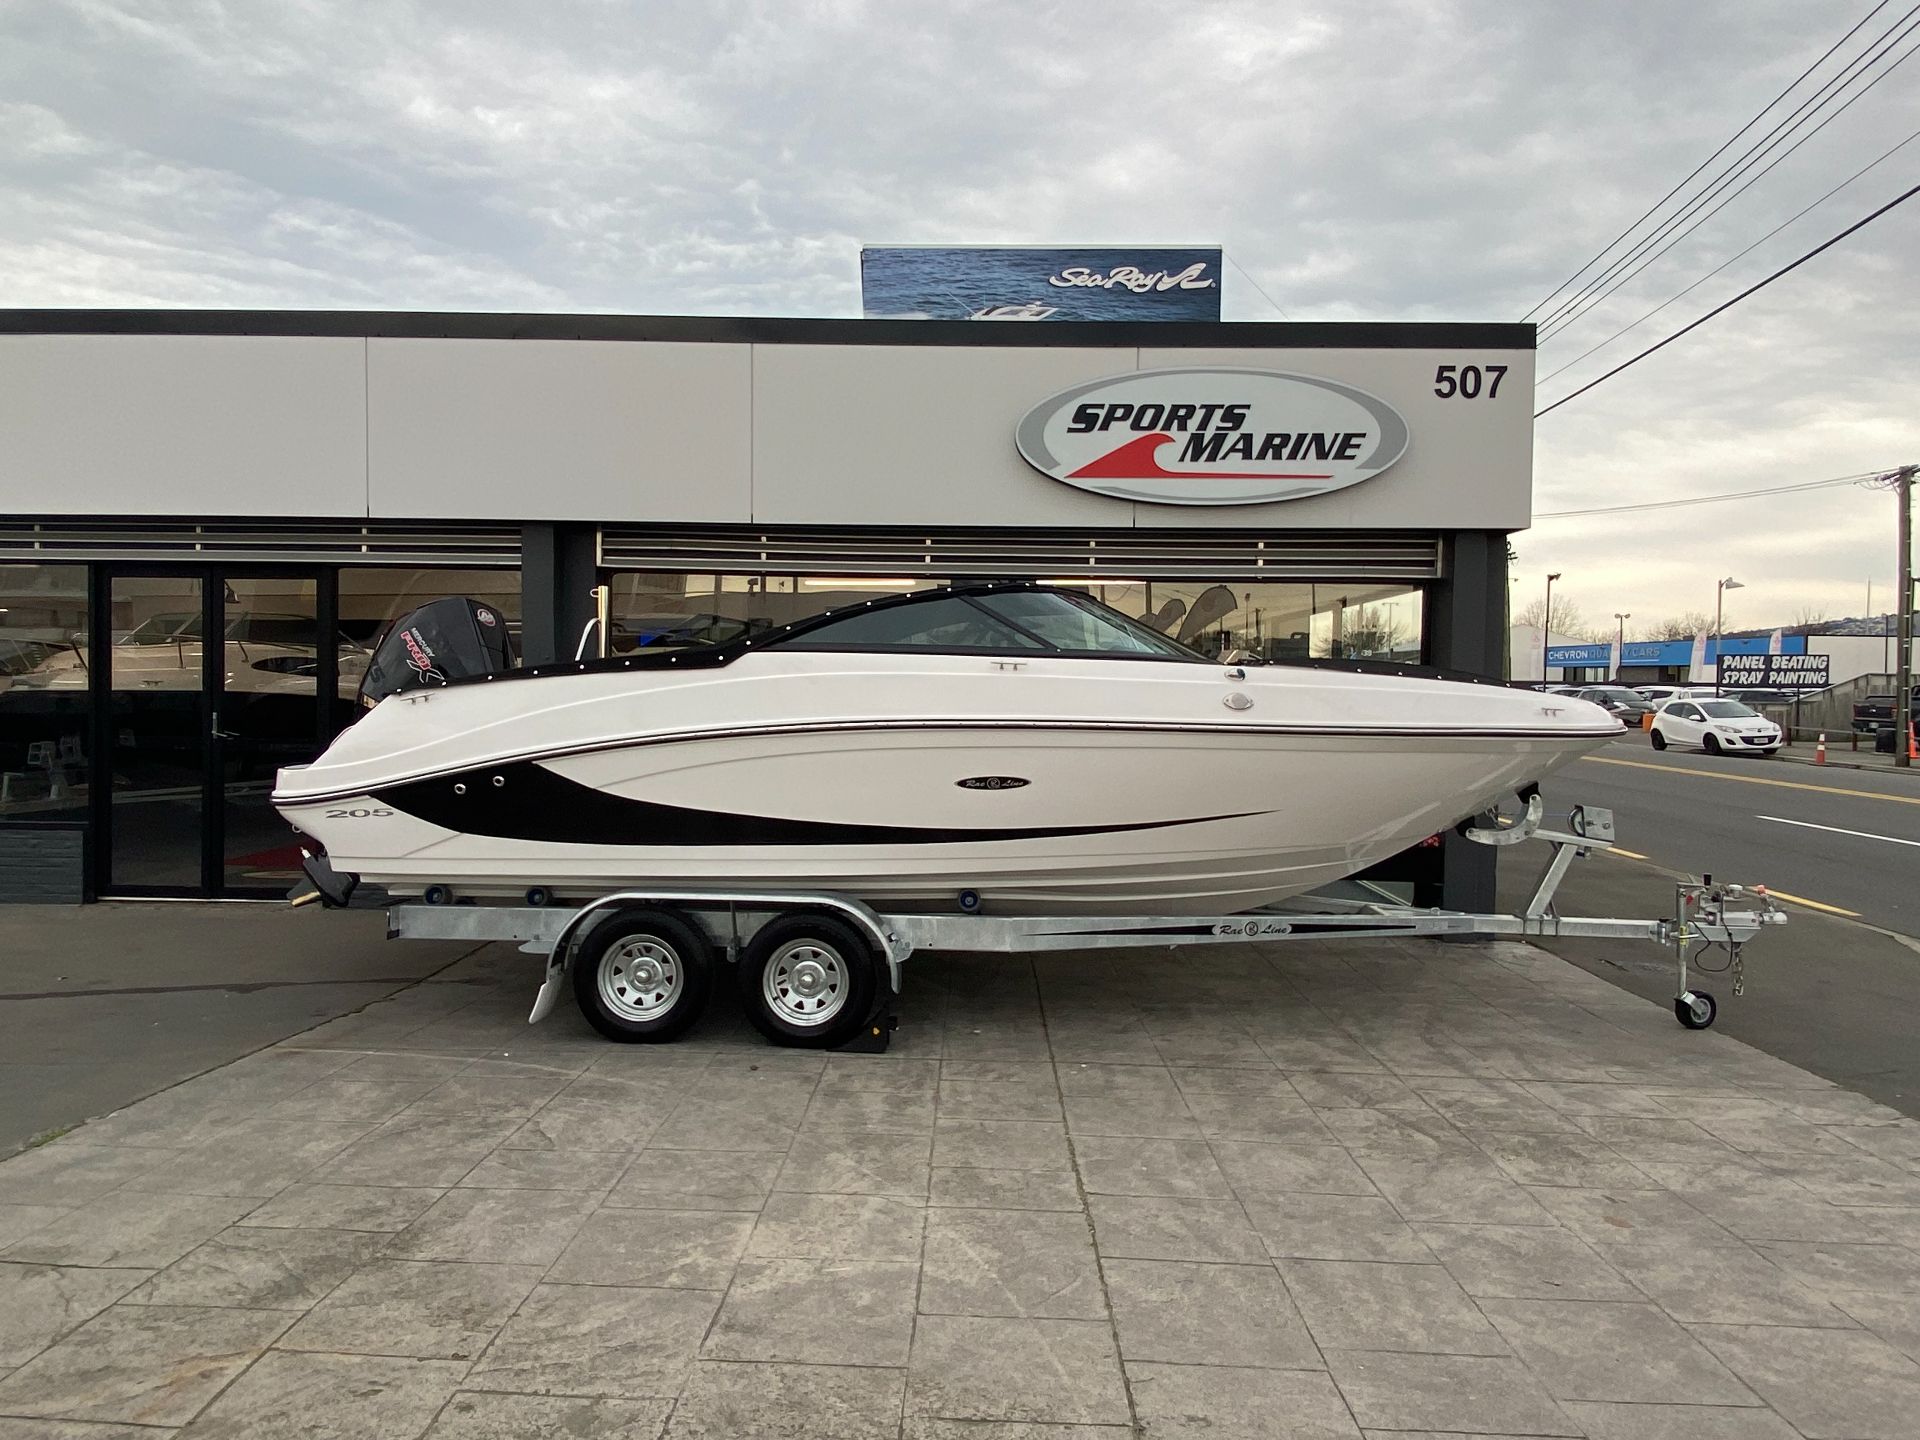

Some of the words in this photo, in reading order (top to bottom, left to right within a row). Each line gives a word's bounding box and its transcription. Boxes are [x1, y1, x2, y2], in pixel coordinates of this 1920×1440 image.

[1049, 267, 1108, 287] Sea
[1104, 266, 1163, 293] Ray
[1434, 365, 1508, 399] 507
[1066, 403, 1251, 433] SPORTS
[1177, 432, 1367, 462] MARINE
[411, 627, 435, 657] MERCURY
[1548, 650, 1588, 660] CHEVRON
[1632, 647, 1660, 657] CARS
[1722, 655, 1766, 669] PANEL
[1771, 655, 1828, 669] BEATING
[1721, 671, 1764, 685] SPRAY
[1768, 671, 1827, 685] PAINTING
[325, 808, 394, 819] 205
[1260, 924, 1288, 934] Line
